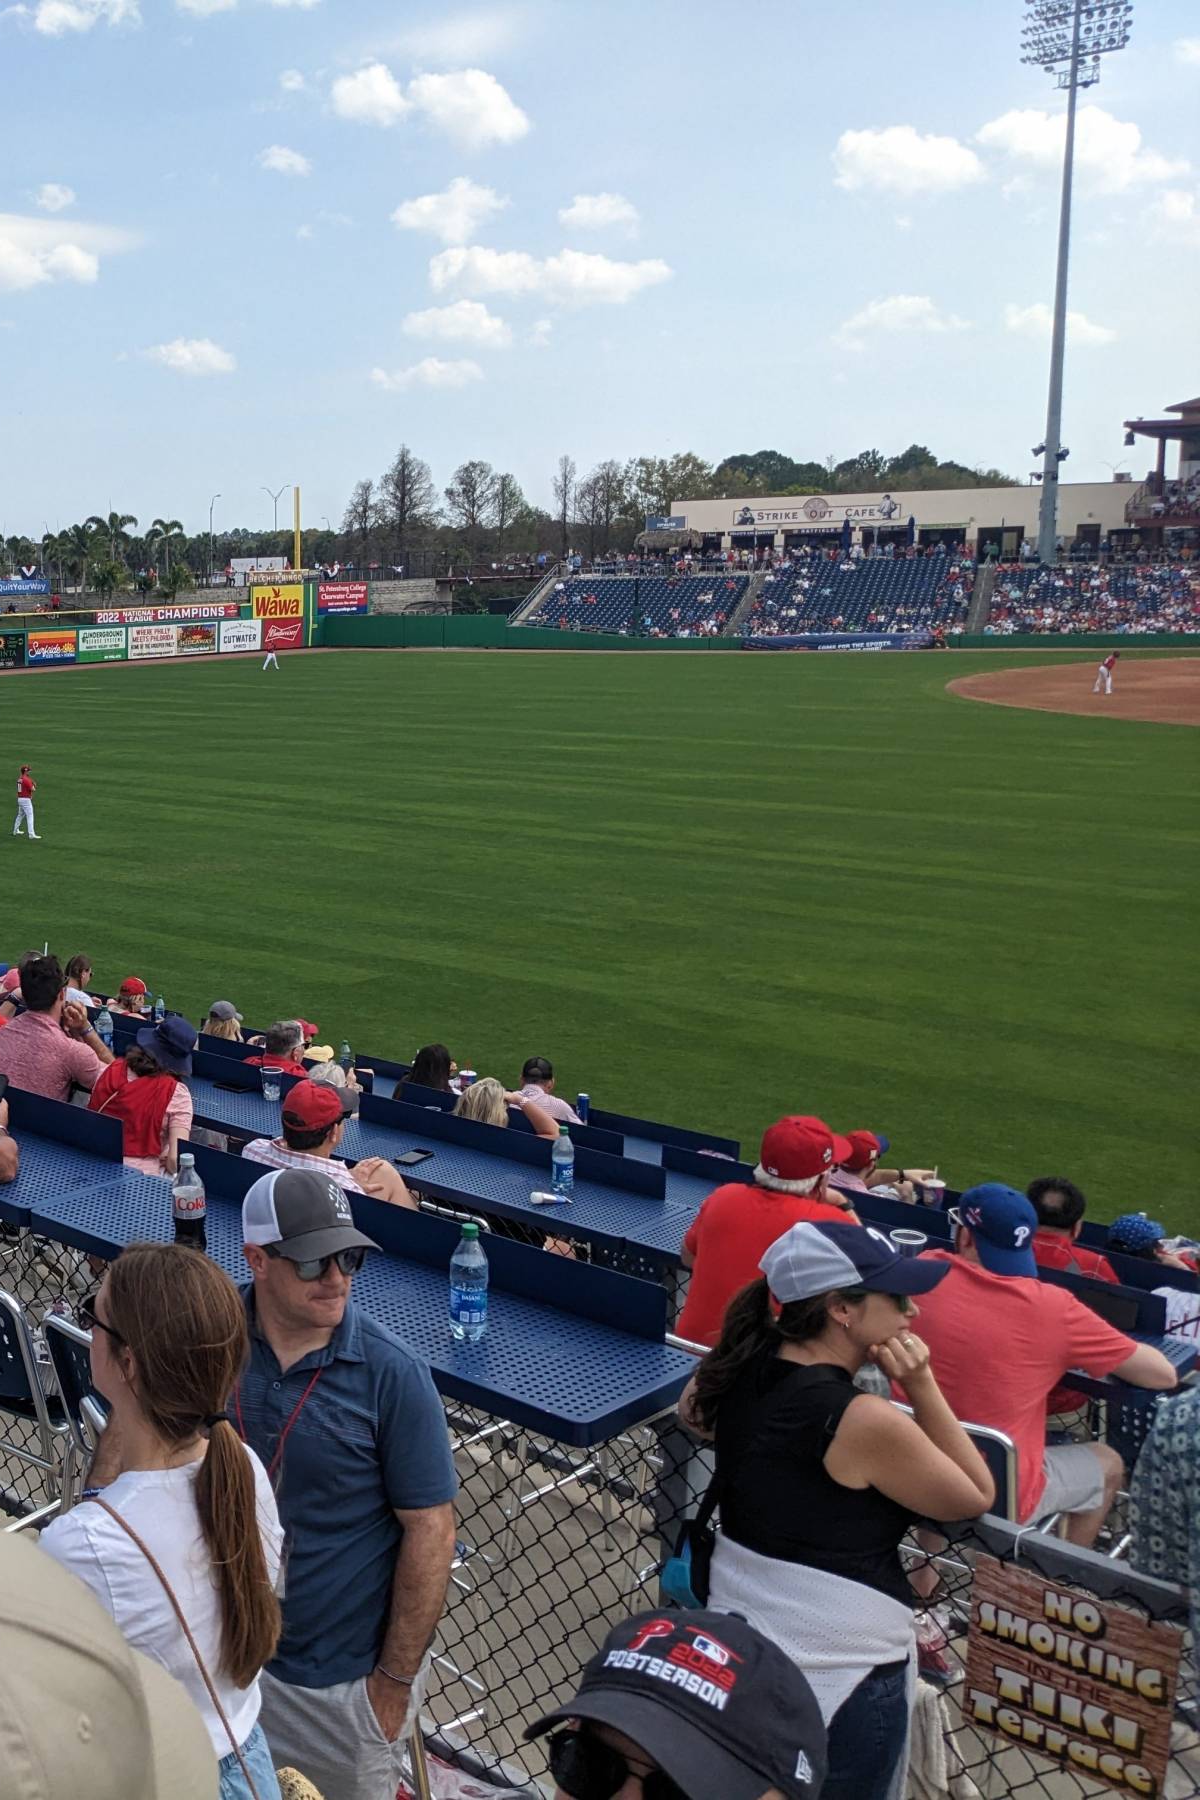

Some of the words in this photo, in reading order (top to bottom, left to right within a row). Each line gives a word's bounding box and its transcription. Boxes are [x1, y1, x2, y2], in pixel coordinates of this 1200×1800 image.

[757, 511, 798, 521] STRIKE
[809, 510, 833, 519] OUT
[845, 507, 875, 517] CAFE
[326, 585, 350, 593] Petersburg
[350, 584, 367, 592] College
[97, 612, 120, 623] 2022
[157, 607, 225, 620] CHAMPIONS
[256, 596, 300, 617] Wawa
[223, 634, 257, 644] CUTWATER
[28, 641, 62, 657] Surfside
[1044, 1590, 1101, 1633] NO
[978, 1602, 1163, 1699] SMOKING
[603, 1650, 730, 1711] POSTSEASON
[995, 1665, 1138, 1750] TIKI
